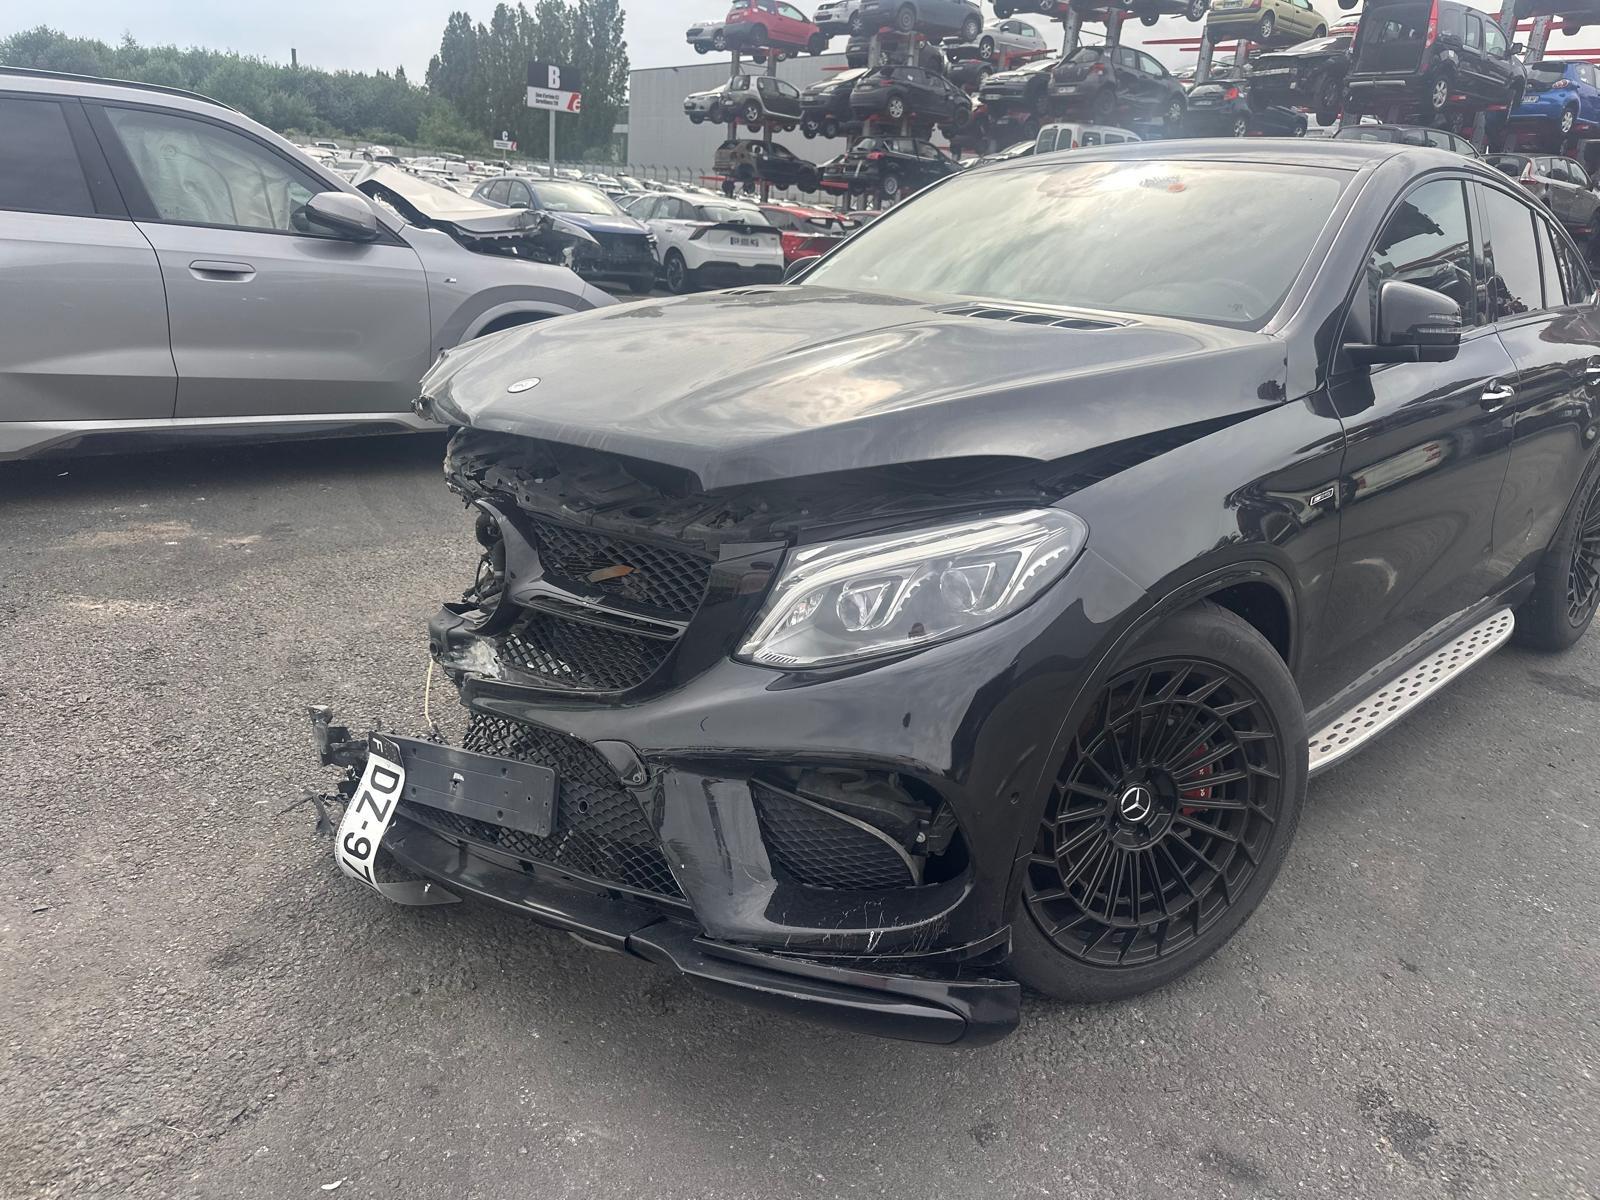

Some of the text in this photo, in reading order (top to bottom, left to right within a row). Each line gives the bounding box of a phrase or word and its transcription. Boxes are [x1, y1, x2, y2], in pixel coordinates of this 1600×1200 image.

[548, 65, 560, 88] B
[502, 131, 508, 140] C
[372, 737, 384, 753] F
